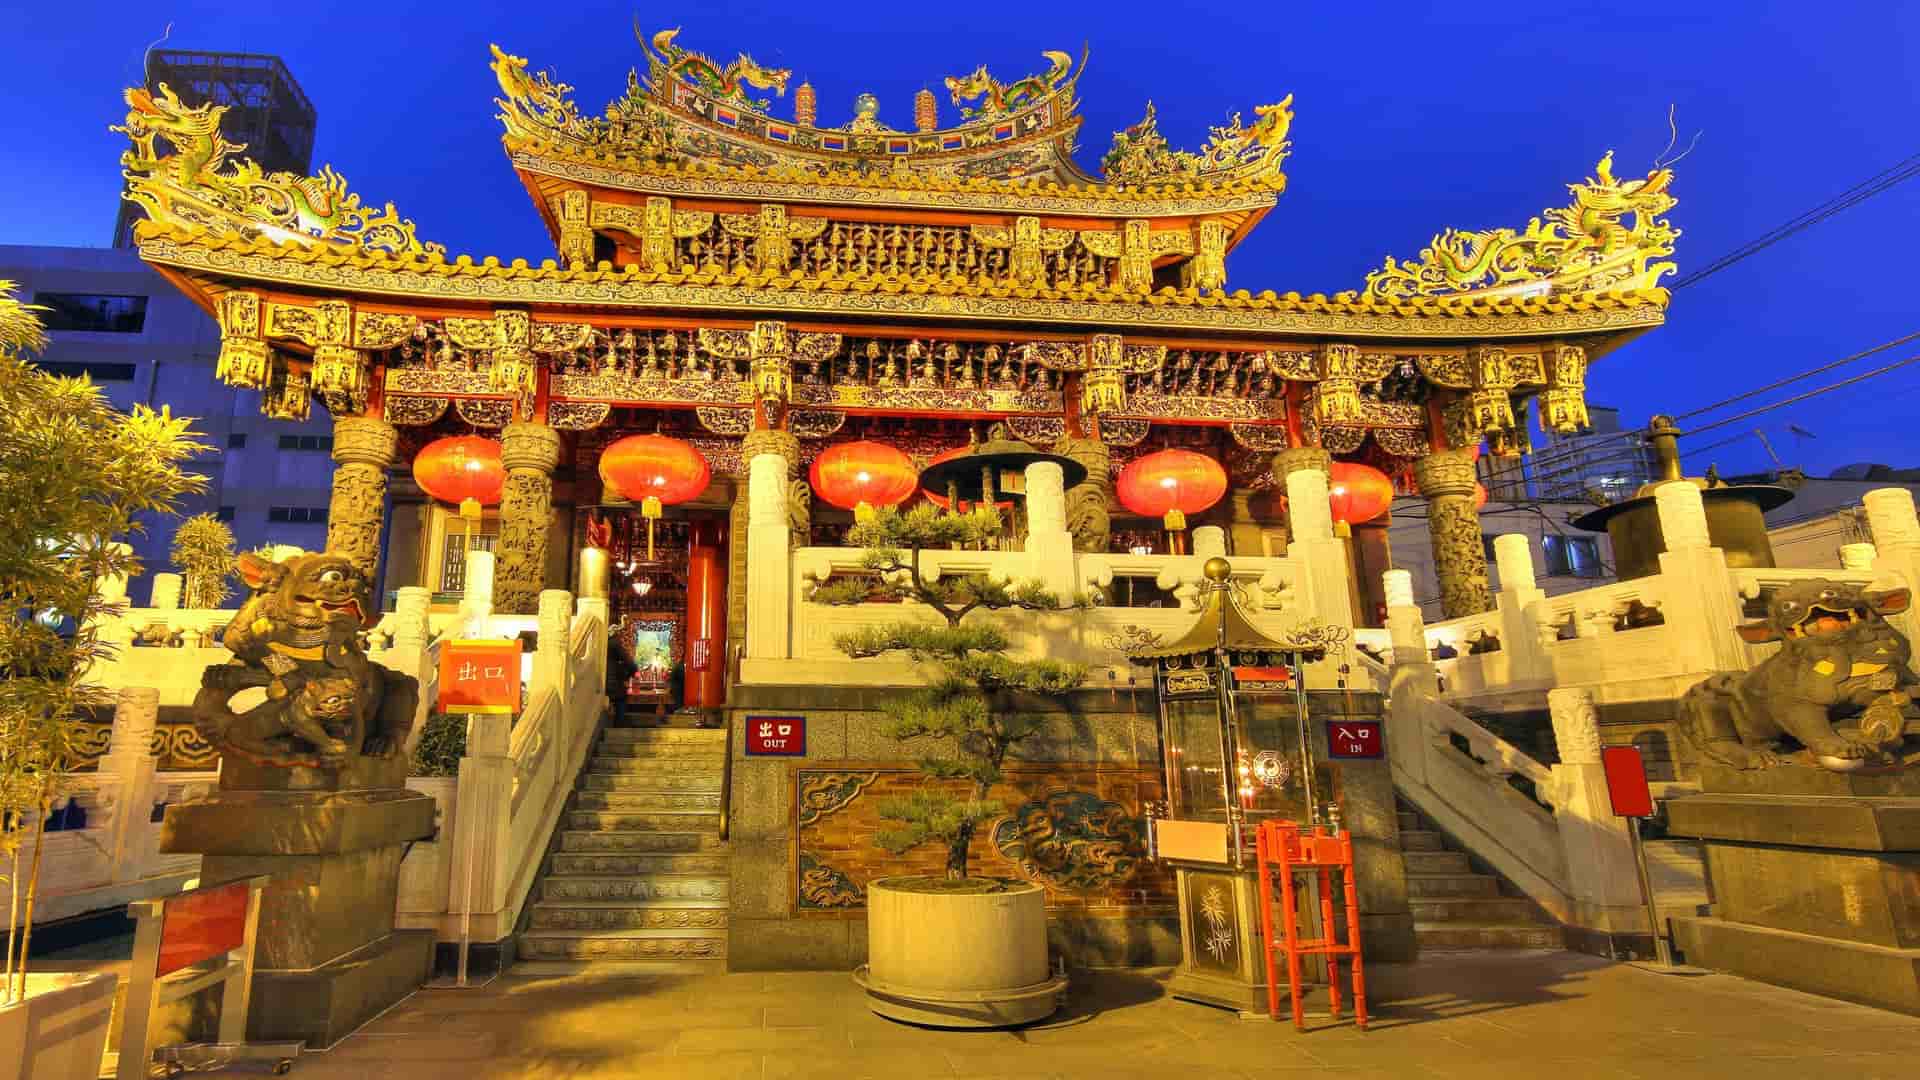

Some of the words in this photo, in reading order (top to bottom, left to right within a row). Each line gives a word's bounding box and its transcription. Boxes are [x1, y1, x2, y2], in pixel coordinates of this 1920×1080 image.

[458, 660, 505, 681] 出口
[759, 722, 792, 737] 出口
[1338, 727, 1369, 740] 入口
[763, 739, 787, 748] OUT
[1350, 743, 1362, 753] IN
